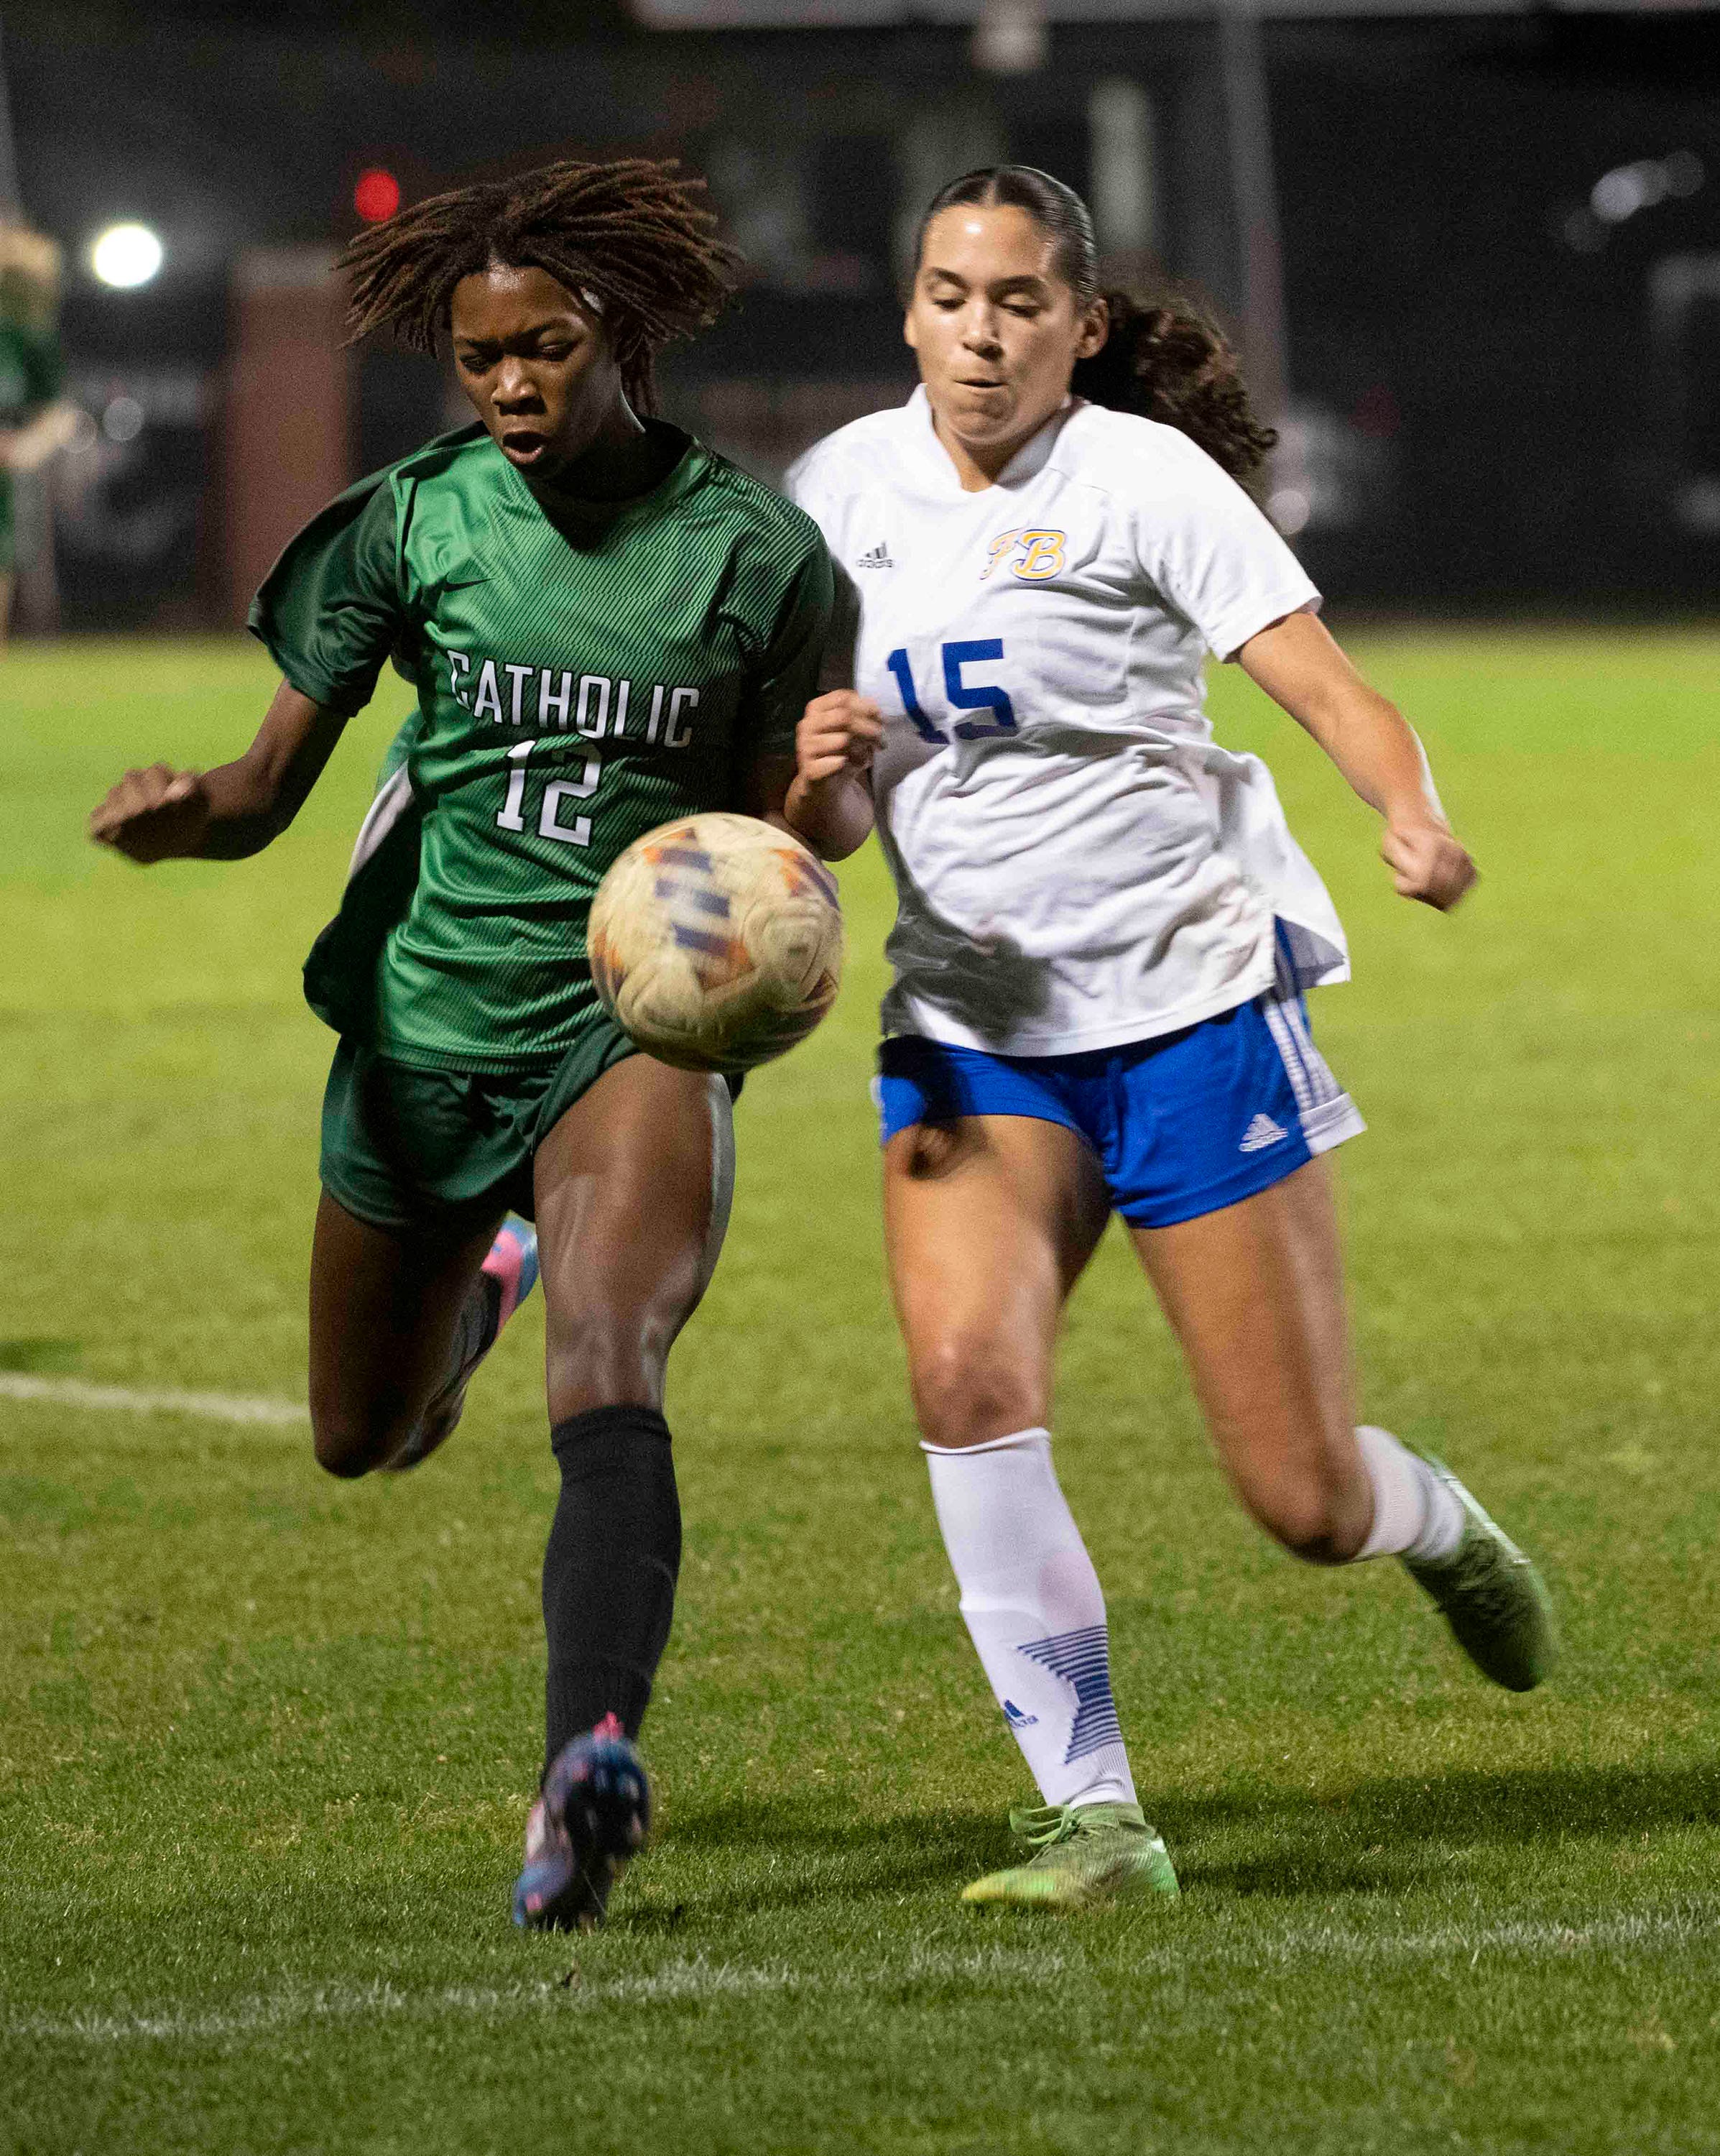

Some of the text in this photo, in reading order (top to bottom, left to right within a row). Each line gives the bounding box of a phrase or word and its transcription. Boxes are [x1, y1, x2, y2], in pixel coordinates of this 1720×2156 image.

[446, 649, 701, 749] CATHOLIC
[887, 637, 1019, 745] 15
[496, 740, 602, 847] 12
